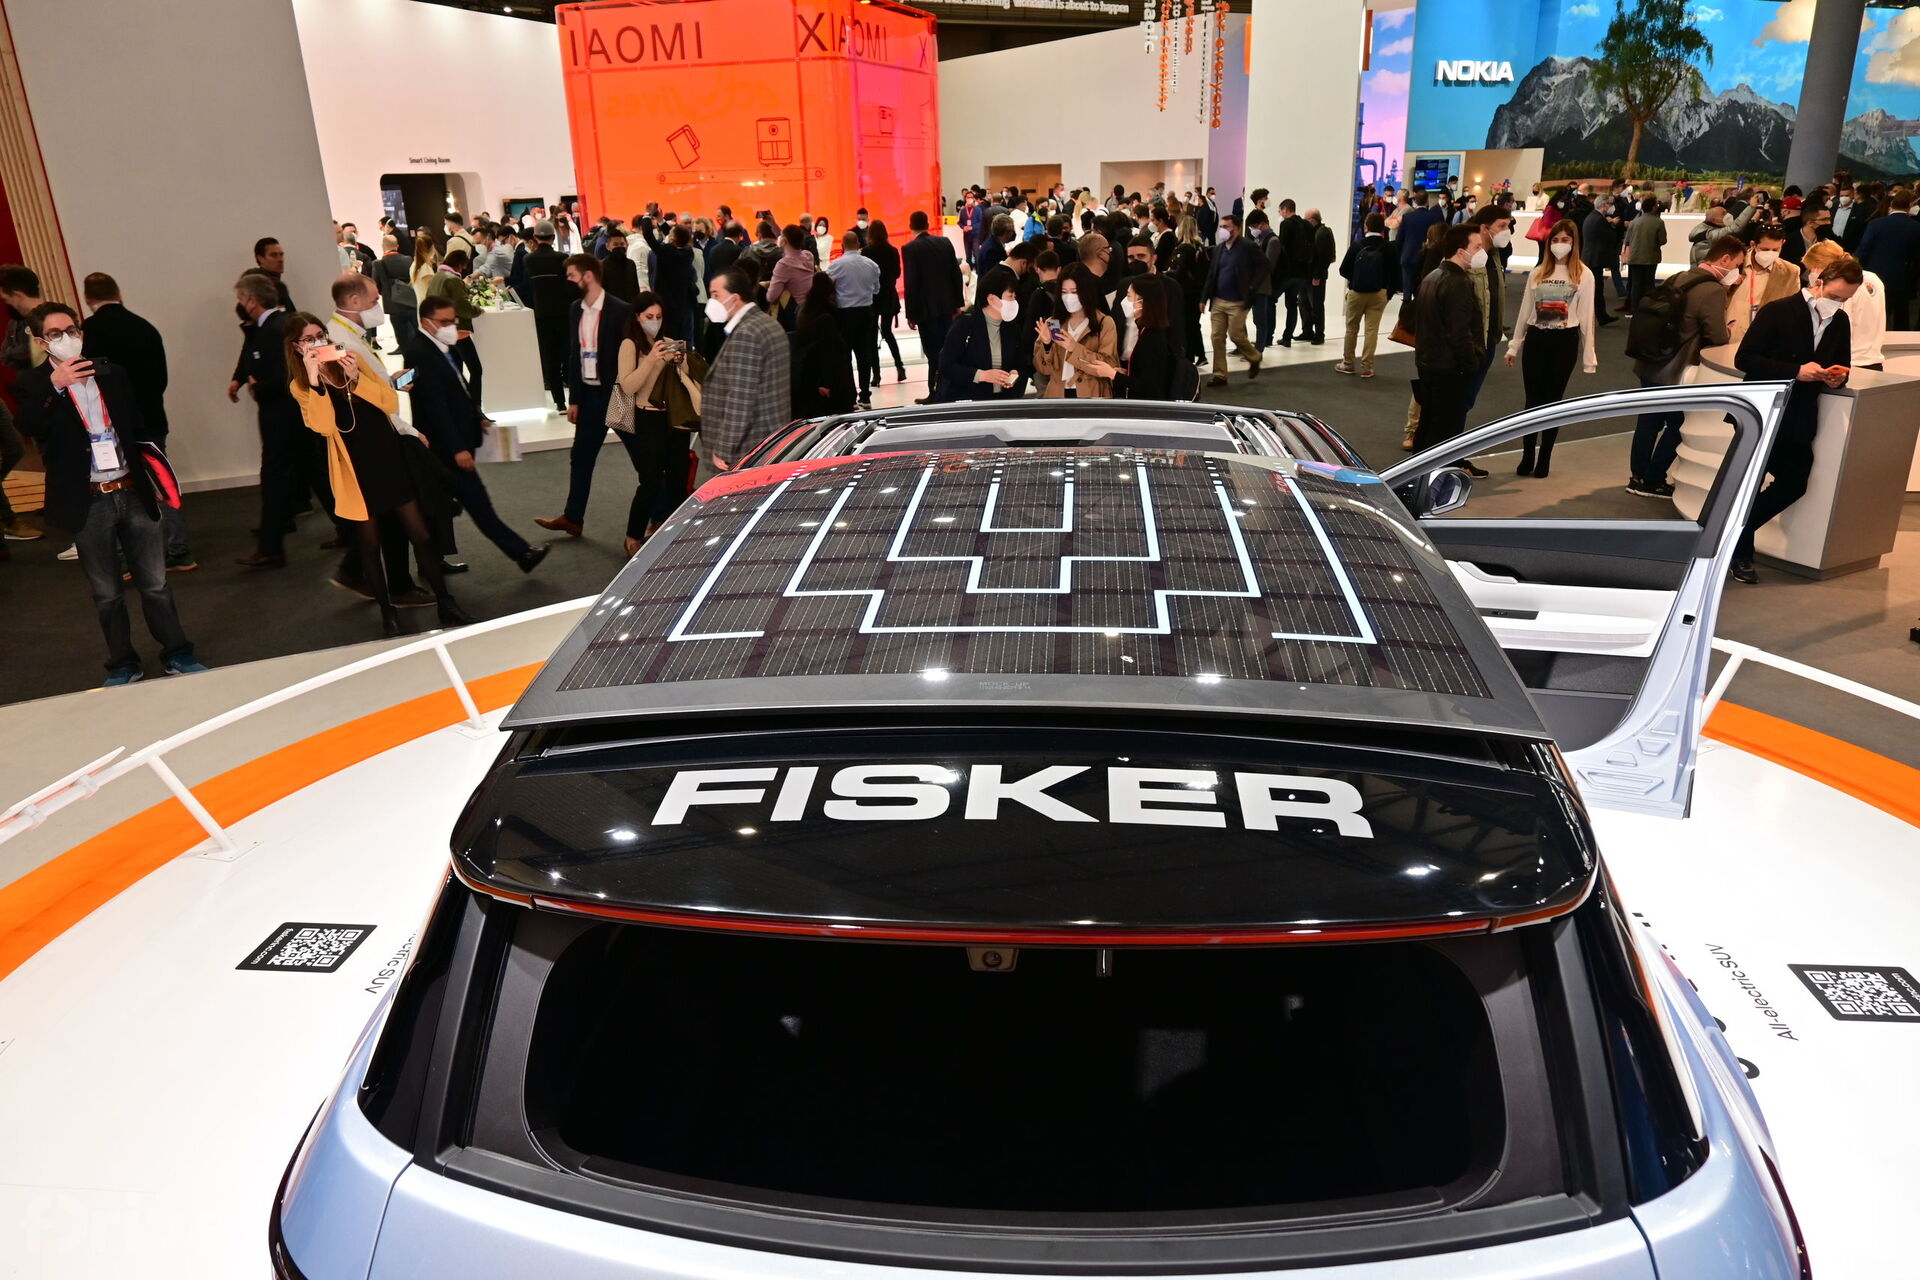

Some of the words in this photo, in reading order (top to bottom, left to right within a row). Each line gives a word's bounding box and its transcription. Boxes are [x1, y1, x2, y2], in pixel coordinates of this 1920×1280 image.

[1065, 0, 1090, 11] about
[1090, 1, 1100, 12] to
[1100, 0, 1130, 15] happen
[1215, 1, 1231, 32] for
[797, 12, 888, 62] XIAOMI
[1209, 37, 1225, 129] everyone
[1436, 59, 1515, 82] NOKIA
[651, 764, 1375, 838] FISKER
[1704, 942, 1738, 969] SUV
[364, 968, 396, 995] SUV
[1731, 970, 1799, 1041] All-electric
